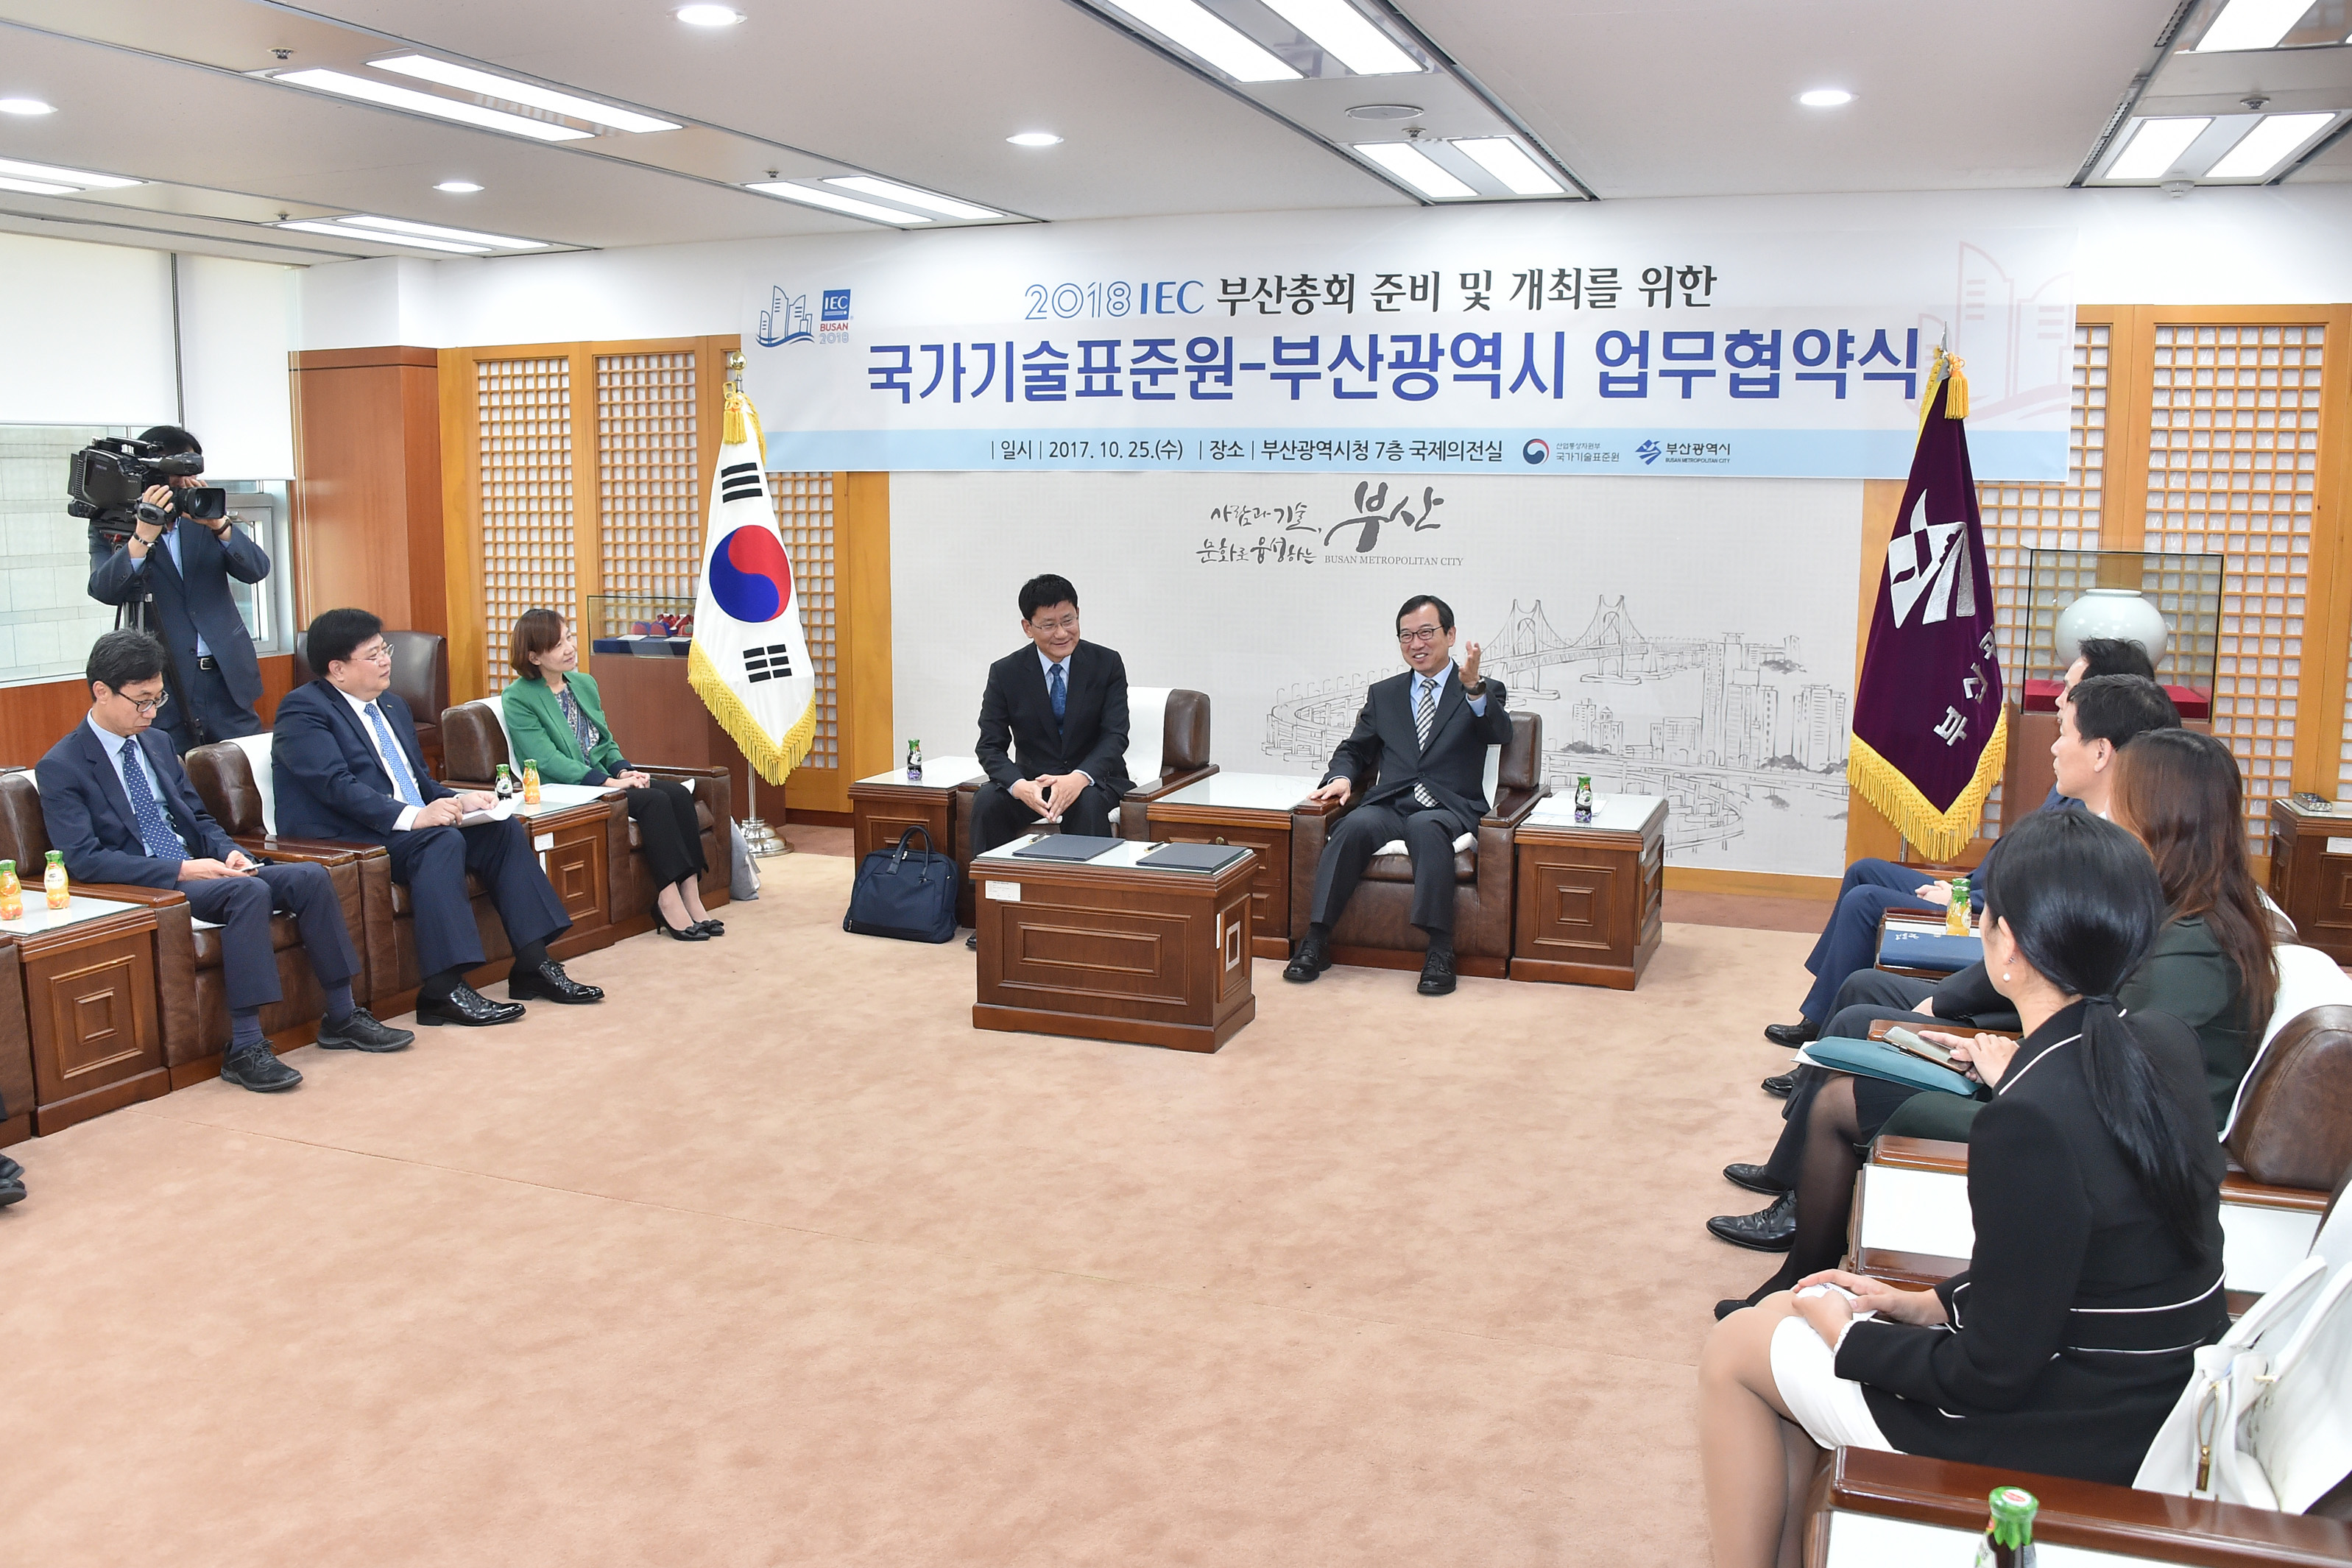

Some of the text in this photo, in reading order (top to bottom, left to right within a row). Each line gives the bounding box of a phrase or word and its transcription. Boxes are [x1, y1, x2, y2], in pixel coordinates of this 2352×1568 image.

[1025, 264, 1717, 320] 2018 IEC 부산총회 준비 및 개최를 위한
[824, 295, 848, 310] IEC
[819, 322, 849, 332] BUSAN
[819, 331, 850, 345] 2018
[868, 328, 1918, 404] 국가기술표준원-부산광역시 업무협약식
[1001, 439, 1031, 460] 일시
[1049, 441, 1094, 459] 2017.
[1101, 441, 1123, 459] 10.
[1209, 439, 1245, 460] 장소
[1261, 439, 1369, 461] 부산광역시청
[1375, 440, 1405, 462] 7층
[1408, 439, 1502, 462] 국제의전실
[1556, 442, 1600, 451] 산업통상자원부
[1666, 442, 1731, 456] 부산광역시
[1556, 452, 1620, 462] 국가기술표준원
[1324, 481, 1444, 554] 부산
[1324, 555, 1463, 566] BUSAN METROPOLITAN CITY
